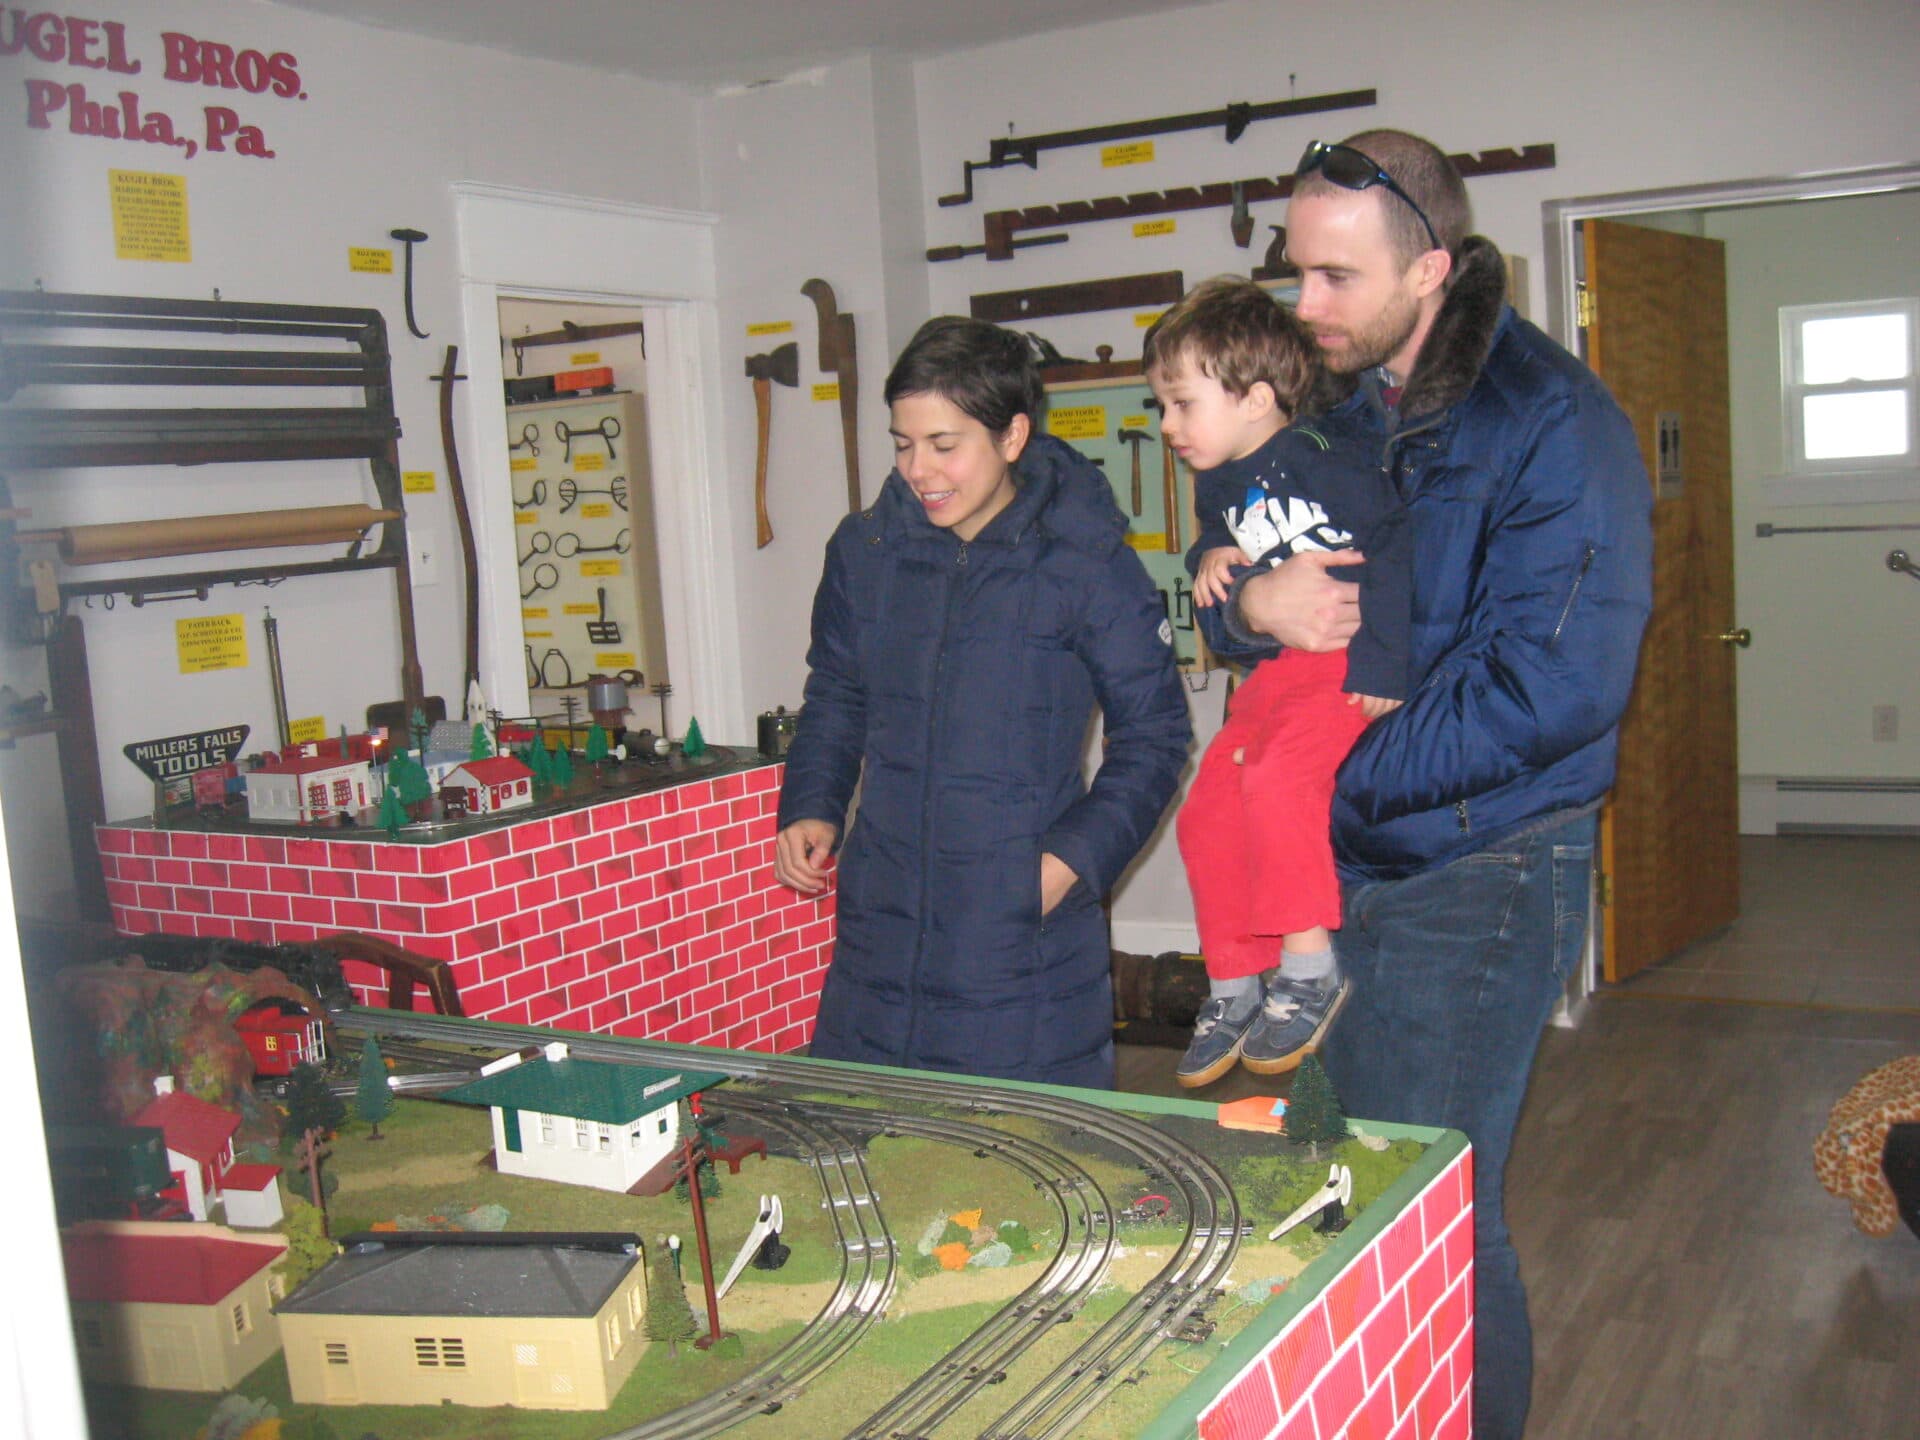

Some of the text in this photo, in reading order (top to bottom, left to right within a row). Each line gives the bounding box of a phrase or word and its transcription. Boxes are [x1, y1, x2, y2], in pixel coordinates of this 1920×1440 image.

[0, 5, 307, 100] UGEL BROS.
[204, 106, 276, 159] Pa.
[135, 729, 241, 761] MILLERS FALLS
[153, 748, 227, 776] TOOLS
